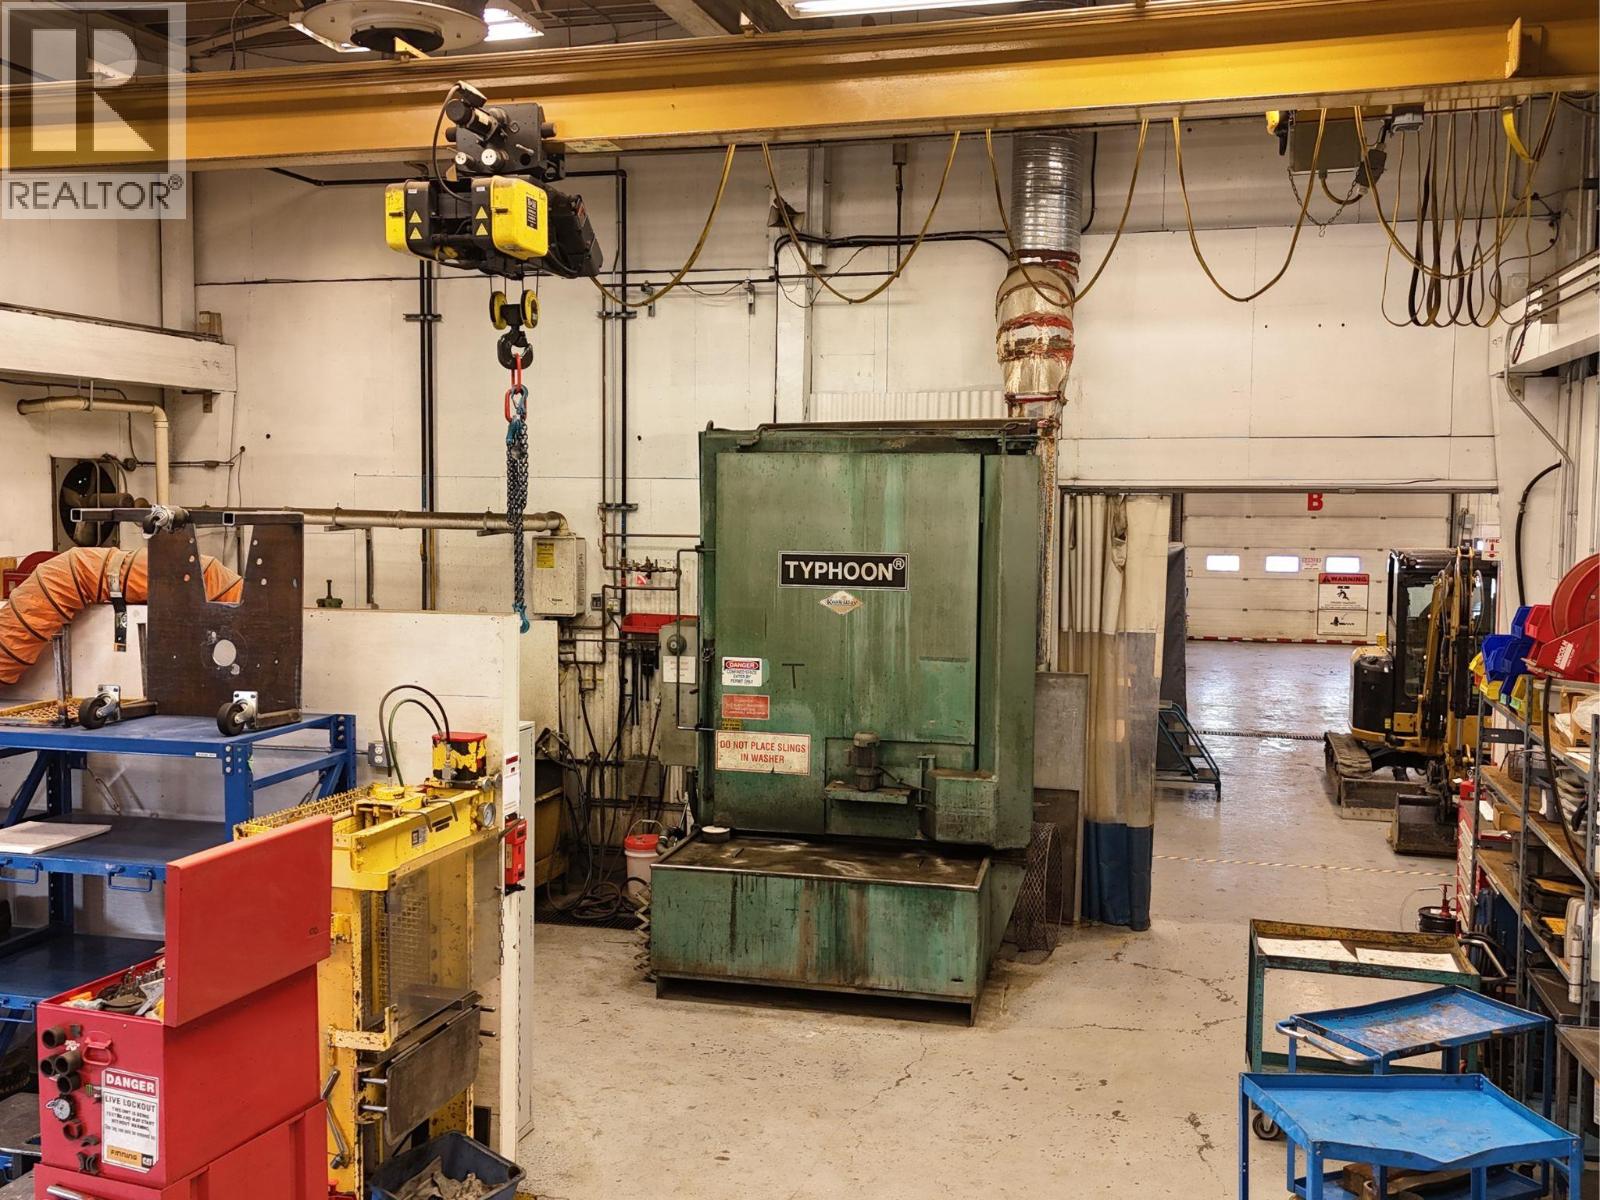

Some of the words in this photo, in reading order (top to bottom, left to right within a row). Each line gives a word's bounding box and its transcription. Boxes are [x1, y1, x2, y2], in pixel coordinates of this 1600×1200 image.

[1307, 492, 1324, 511] B
[785, 557, 905, 581] TYPHOON®
[1331, 575, 1367, 583] WARNING
[729, 661, 755, 669] DANGER
[720, 740, 731, 749] DO
[733, 741, 748, 750] NOT
[751, 741, 775, 751] PLACE
[777, 743, 806, 753] SLINGS
[740, 752, 749, 761] IN
[751, 753, 785, 763] WASHER
[106, 1073, 155, 1094] DANGER
[105, 1096, 121, 1105] LIVE
[123, 1099, 156, 1112] LOCKOUT
